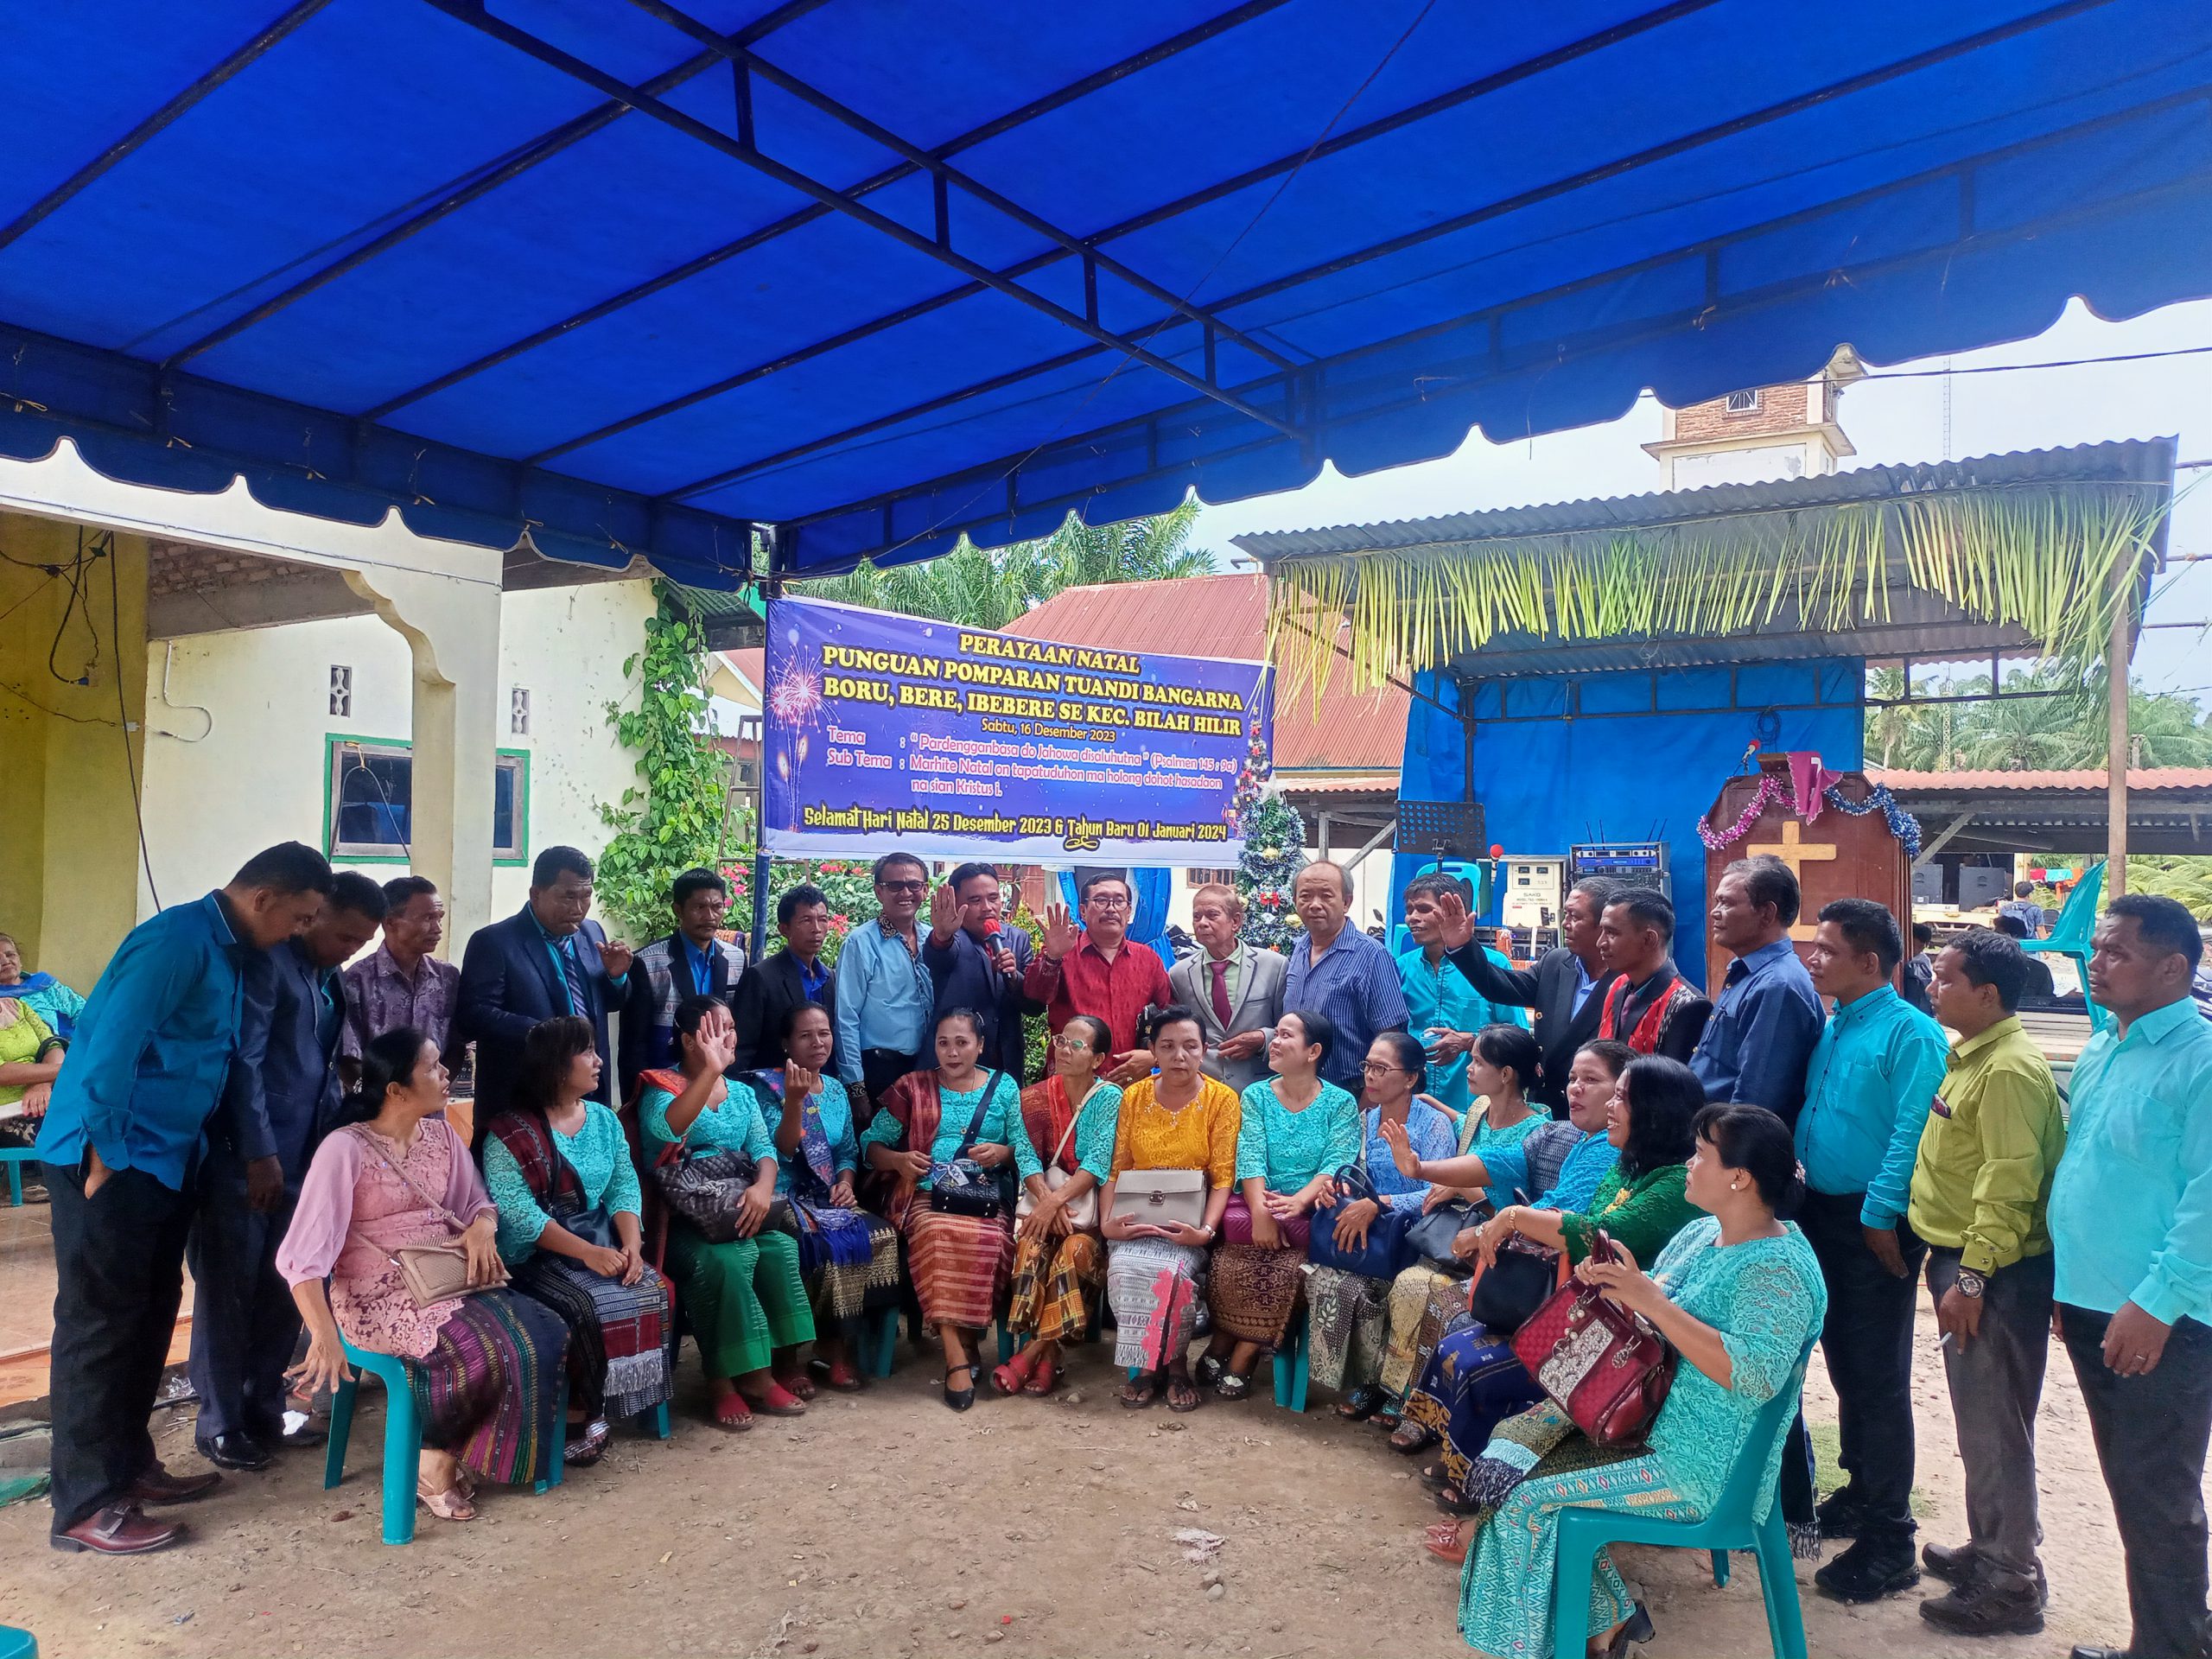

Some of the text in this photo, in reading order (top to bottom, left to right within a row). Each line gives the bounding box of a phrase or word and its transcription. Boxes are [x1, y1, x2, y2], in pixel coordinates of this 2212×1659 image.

[960, 633, 1141, 674] PERAYAAN NATAL
[823, 645, 1243, 710] PUNGUAN POMPARAN TUANDI BANGARNA
[823, 677, 1242, 736] BORU, BERE, IBEBERE SE KEC. BILAH HILIR
[828, 727, 866, 745] Tema
[920, 736, 1020, 758] Pardengganbasa
[1020, 746, 1036, 757] do
[1038, 747, 1080, 761] Jahowa
[1081, 751, 1142, 766] disaluhutna
[1151, 755, 1198, 771] (Psalmen
[1198, 758, 1215, 771] 145
[1221, 760, 1238, 773] 9a)
[981, 718, 1116, 742] Sabtu, 16 Desember 2023
[828, 749, 852, 765] Sub
[855, 752, 892, 769] Tema
[911, 755, 957, 774] Marhite
[959, 760, 993, 775] Natal
[995, 766, 1010, 776] on
[1013, 766, 1084, 782] tapatuduhon
[1086, 771, 1104, 782] ma
[1107, 771, 1142, 786] holong
[1144, 774, 1174, 786] dohot
[1176, 776, 1223, 790] hasadaon
[912, 779, 1002, 797] na sian Kristus i.
[804, 805, 862, 827] Selamat
[863, 810, 892, 831] Hari
[896, 809, 929, 832] Natal
[931, 814, 950, 831] 25
[953, 812, 1017, 834] Desember
[1019, 817, 1052, 835] 2023
[1068, 816, 1103, 850] Tahun
[1106, 822, 1134, 838] Baru
[1152, 823, 1196, 841] Januari
[1198, 825, 1227, 841] 2024
